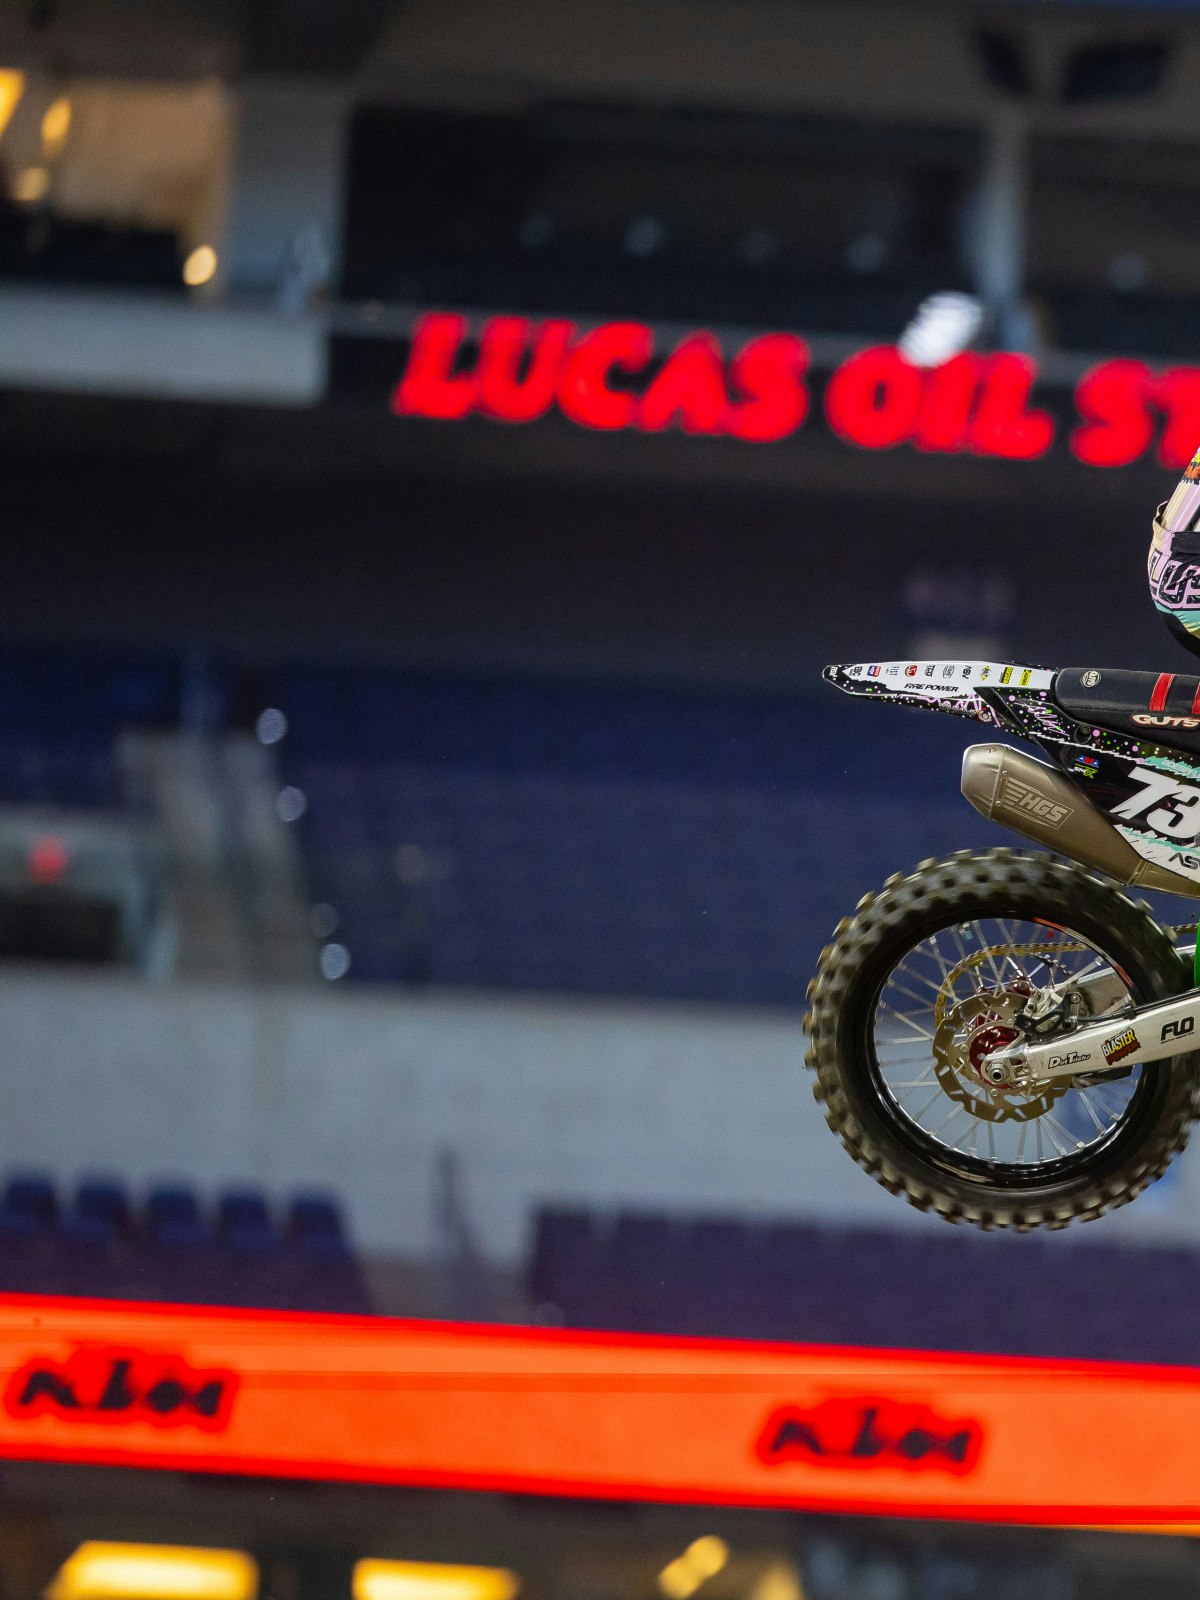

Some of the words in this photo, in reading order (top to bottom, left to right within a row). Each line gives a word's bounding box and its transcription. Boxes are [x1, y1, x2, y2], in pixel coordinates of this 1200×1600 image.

[394, 312, 810, 444] LUCAS
[824, 345, 1056, 462] OIL
[925, 683, 959, 693] POWER
[1019, 792, 1068, 822] HGS
[1160, 1016, 1195, 1041] FLO
[1101, 1030, 1136, 1057] BLASTER
